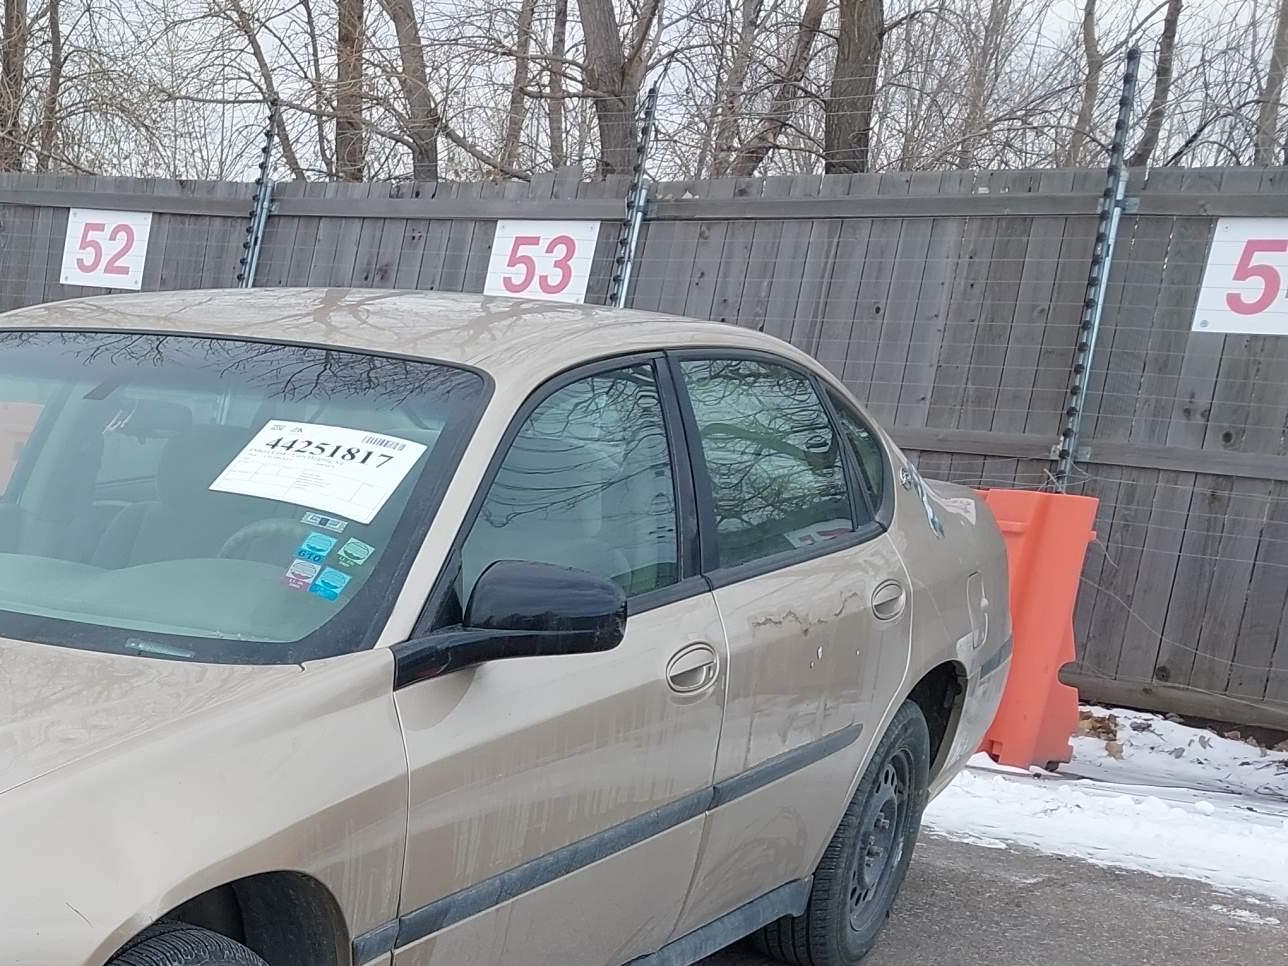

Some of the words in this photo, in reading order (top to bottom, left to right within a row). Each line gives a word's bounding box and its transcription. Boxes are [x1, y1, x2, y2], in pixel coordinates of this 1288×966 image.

[76, 222, 135, 275] 52
[502, 235, 577, 295] 53
[1225, 239, 1288, 315] 5
[265, 436, 394, 469] 44251817
